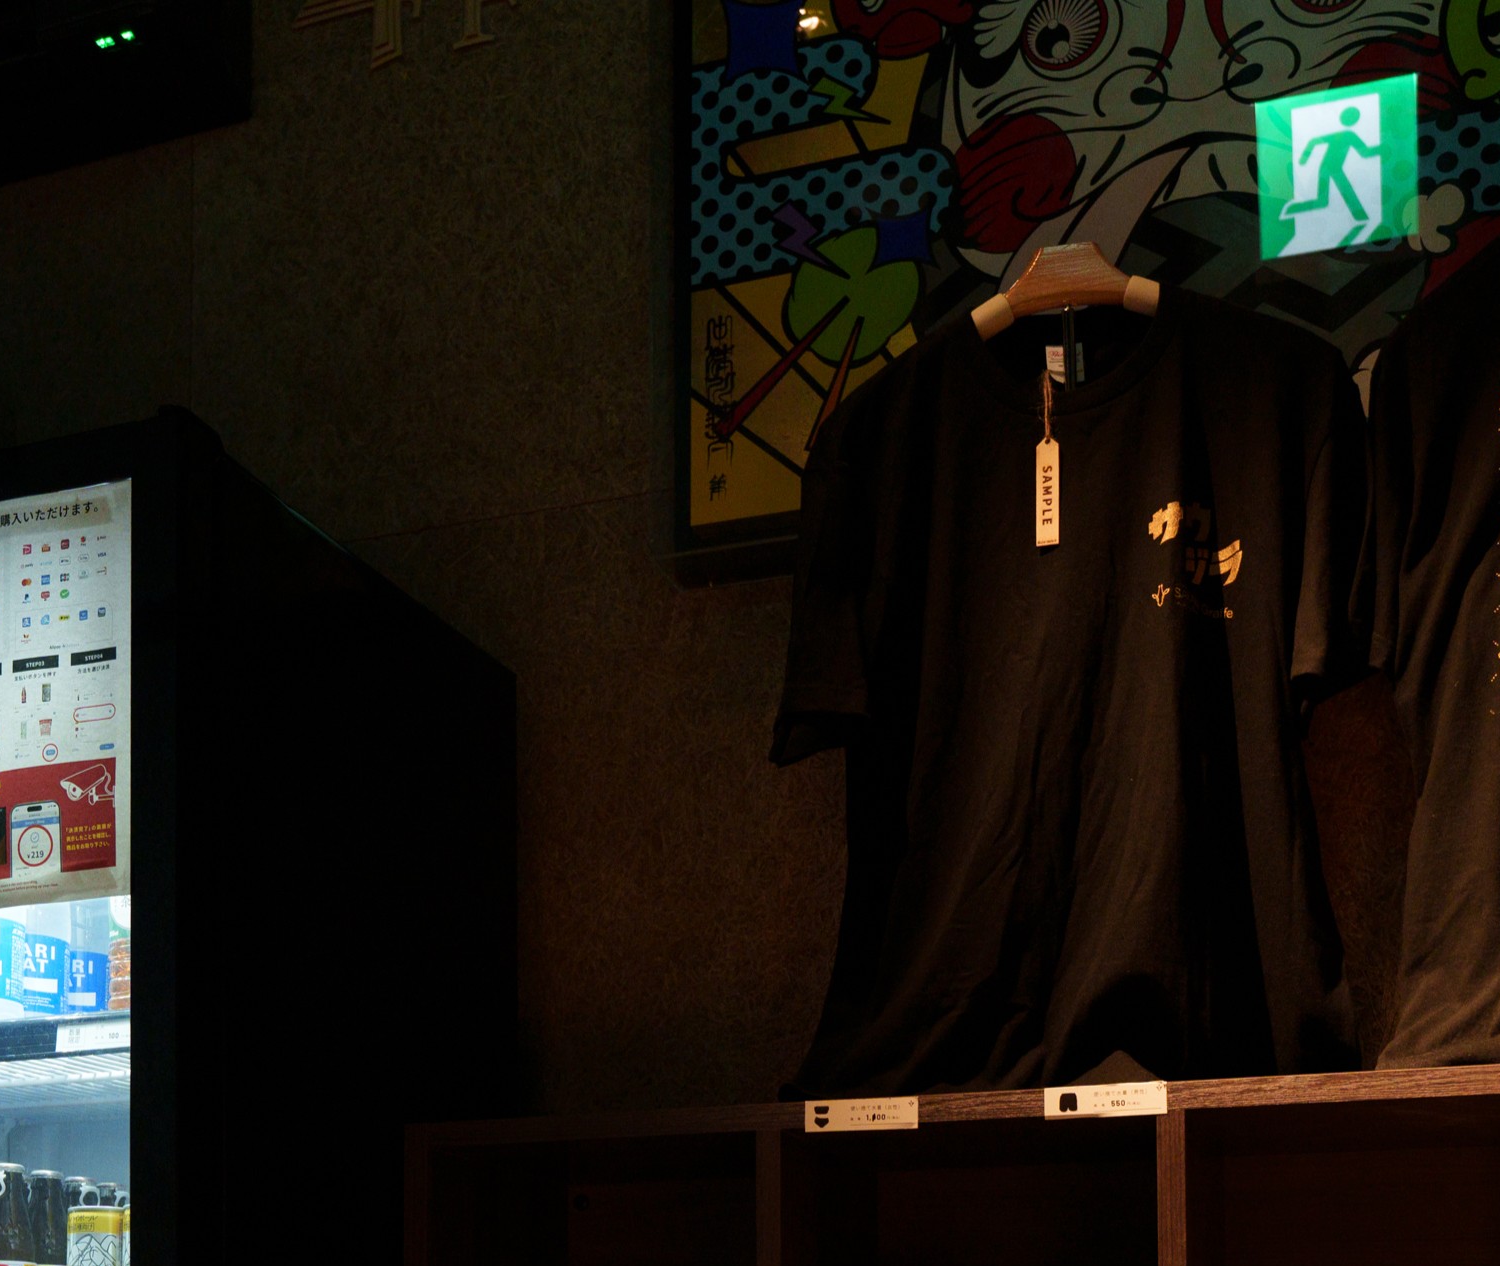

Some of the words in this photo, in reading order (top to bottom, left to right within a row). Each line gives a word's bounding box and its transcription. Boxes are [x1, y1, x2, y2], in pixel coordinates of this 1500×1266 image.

[1042, 466, 1053, 525] SAMPLE
[84, 653, 103, 661] STEP04
[25, 661, 45, 669] STEP03
